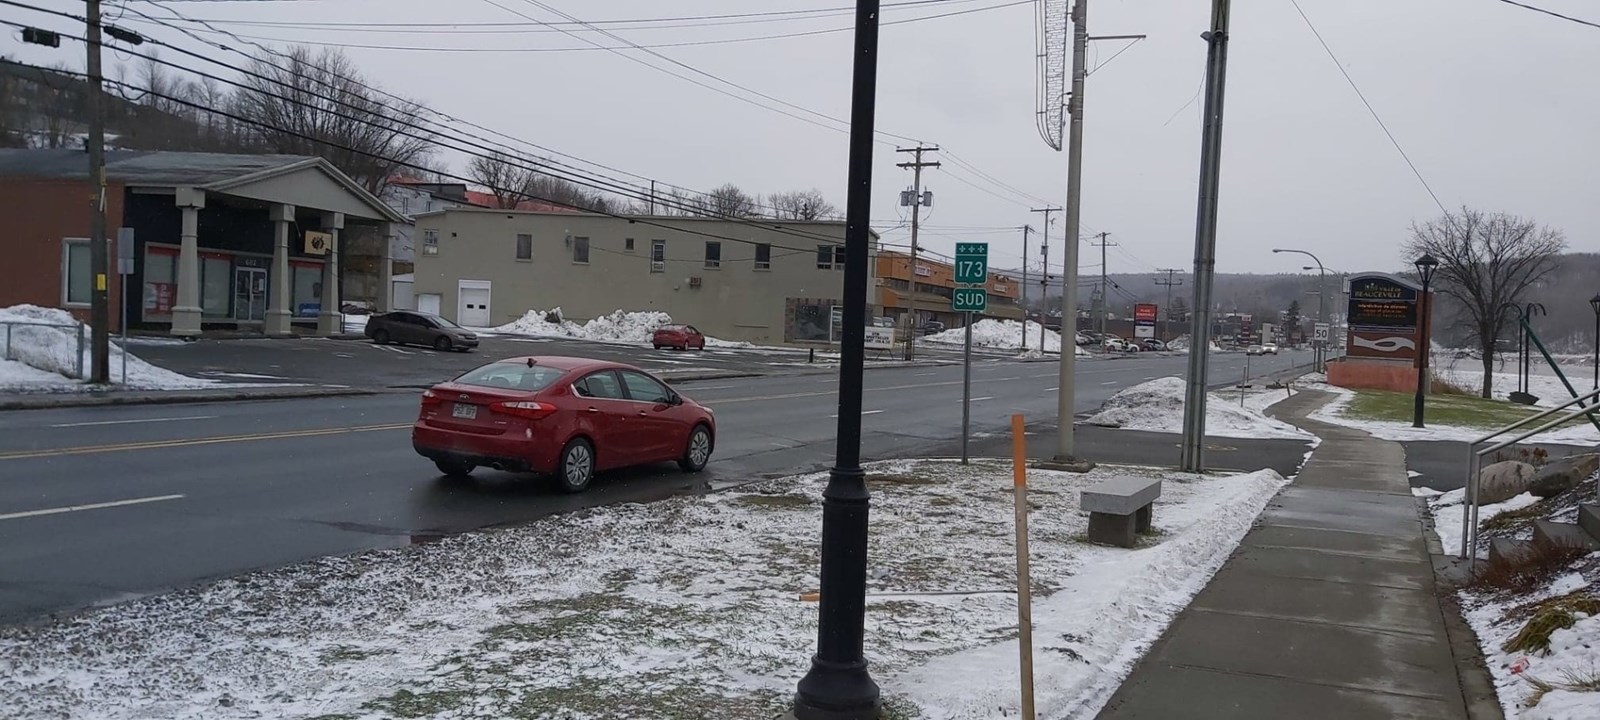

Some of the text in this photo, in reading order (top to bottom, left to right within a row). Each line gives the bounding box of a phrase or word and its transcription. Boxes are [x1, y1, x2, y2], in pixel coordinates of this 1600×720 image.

[958, 261, 983, 278] 173
[956, 293, 984, 306] SUD
[1355, 290, 1402, 298] BEAUCEVILLE
[1316, 329, 1327, 338] 50
